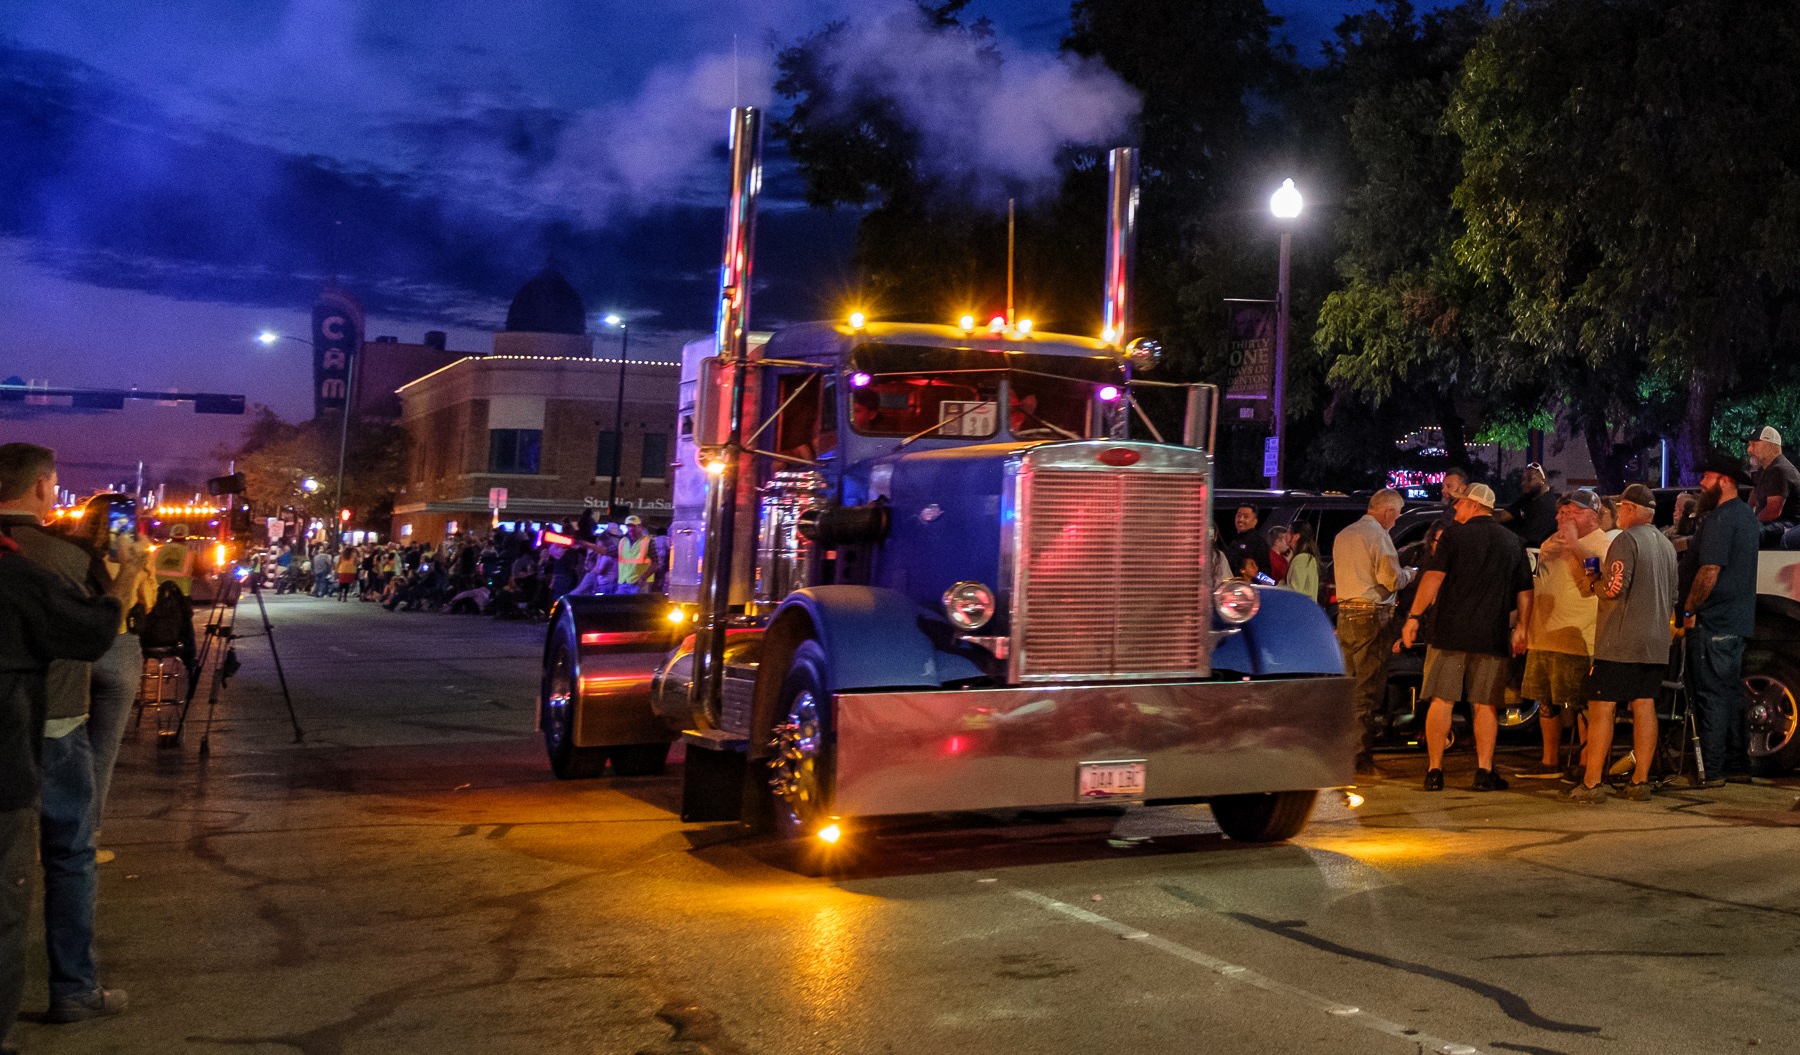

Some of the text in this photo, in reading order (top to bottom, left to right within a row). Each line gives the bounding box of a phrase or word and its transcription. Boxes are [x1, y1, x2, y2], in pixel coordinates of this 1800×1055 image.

[1231, 338, 1270, 350] THIRTY
[1229, 348, 1269, 367] ONE
[1228, 365, 1253, 377] DAYS
[1227, 374, 1269, 386] DENTON
[637, 498, 674, 510] LaSa
